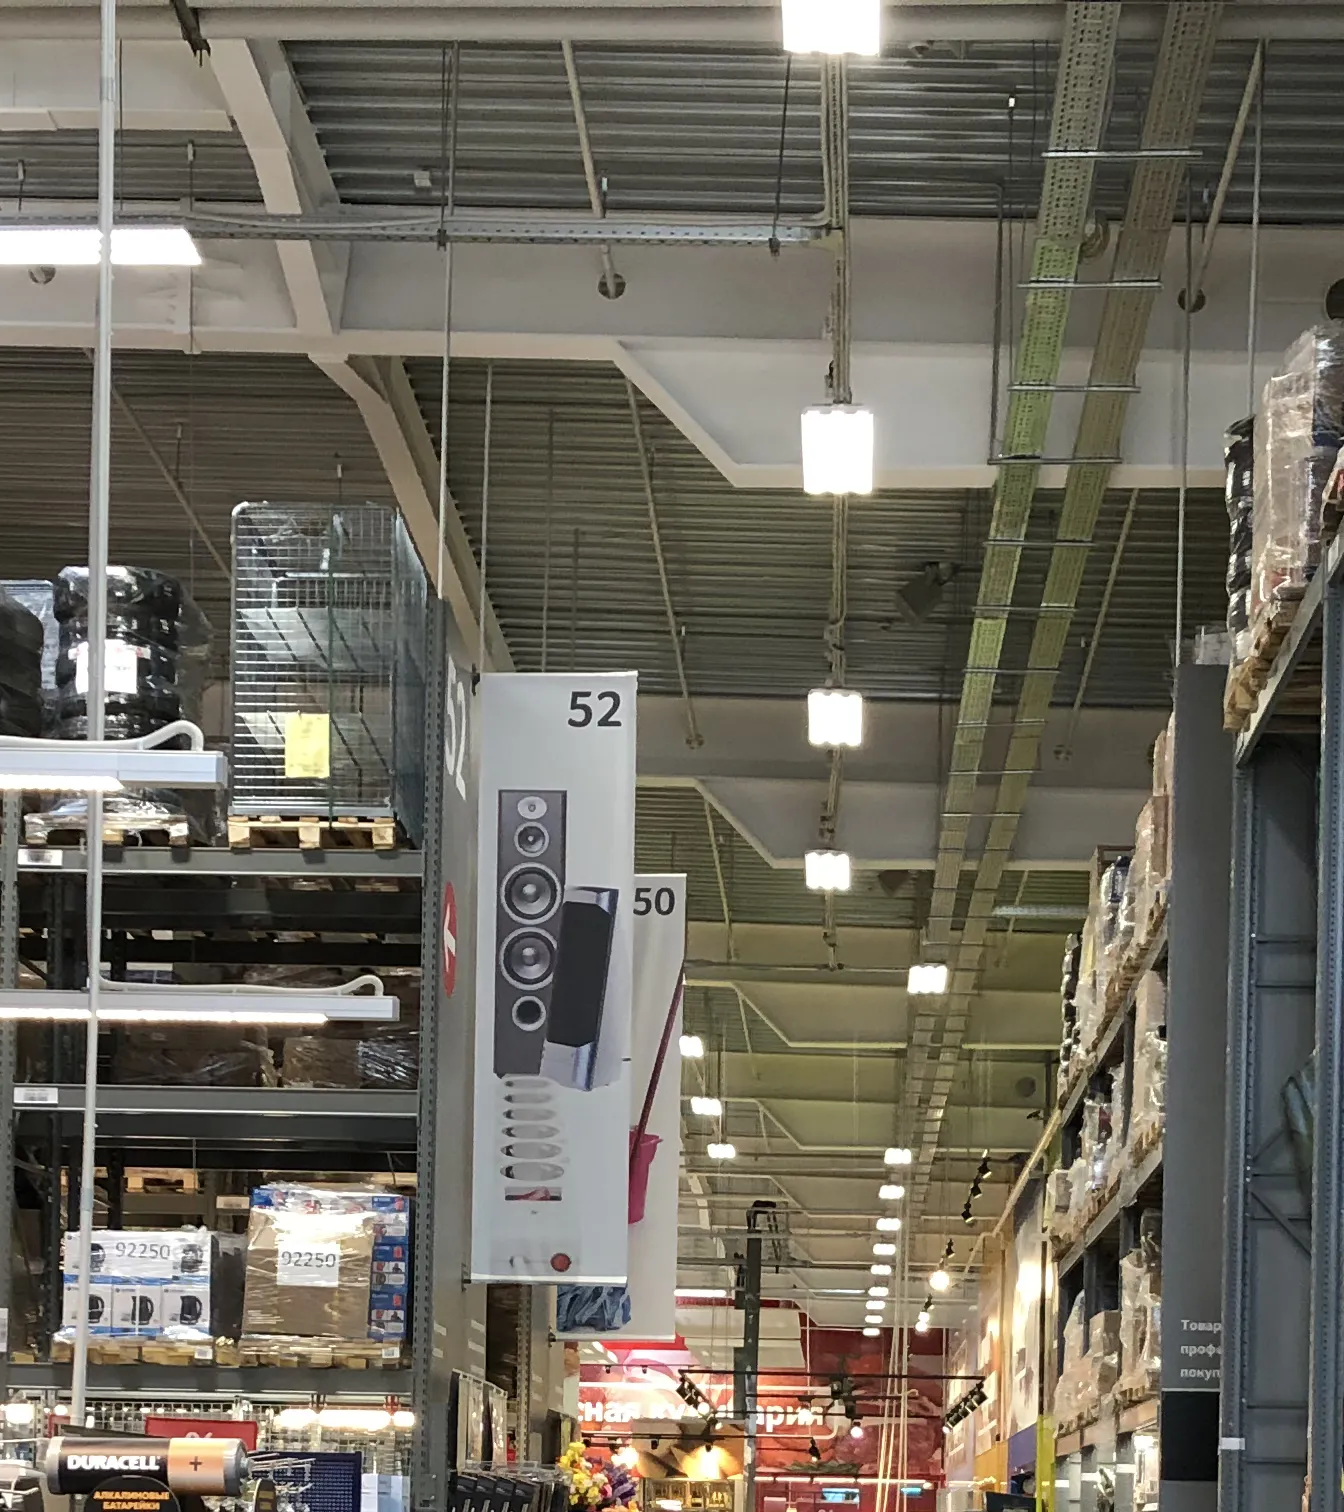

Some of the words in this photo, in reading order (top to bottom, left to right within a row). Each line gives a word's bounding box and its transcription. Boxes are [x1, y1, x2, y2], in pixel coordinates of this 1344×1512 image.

[567, 690, 622, 728] 52
[632, 886, 676, 916] 50
[115, 1242, 171, 1260] 92250
[281, 1250, 337, 1268] 92250
[1180, 1319, 1222, 1334] Товар
[1180, 1343, 1223, 1358] профе
[1180, 1368, 1221, 1381] покуп
[67, 1455, 160, 1471] DURACELL
[93, 1490, 170, 1501] АЛКАЛИНОВЫЕ
[102, 1500, 160, 1511] БАТАРЕЙКИ
